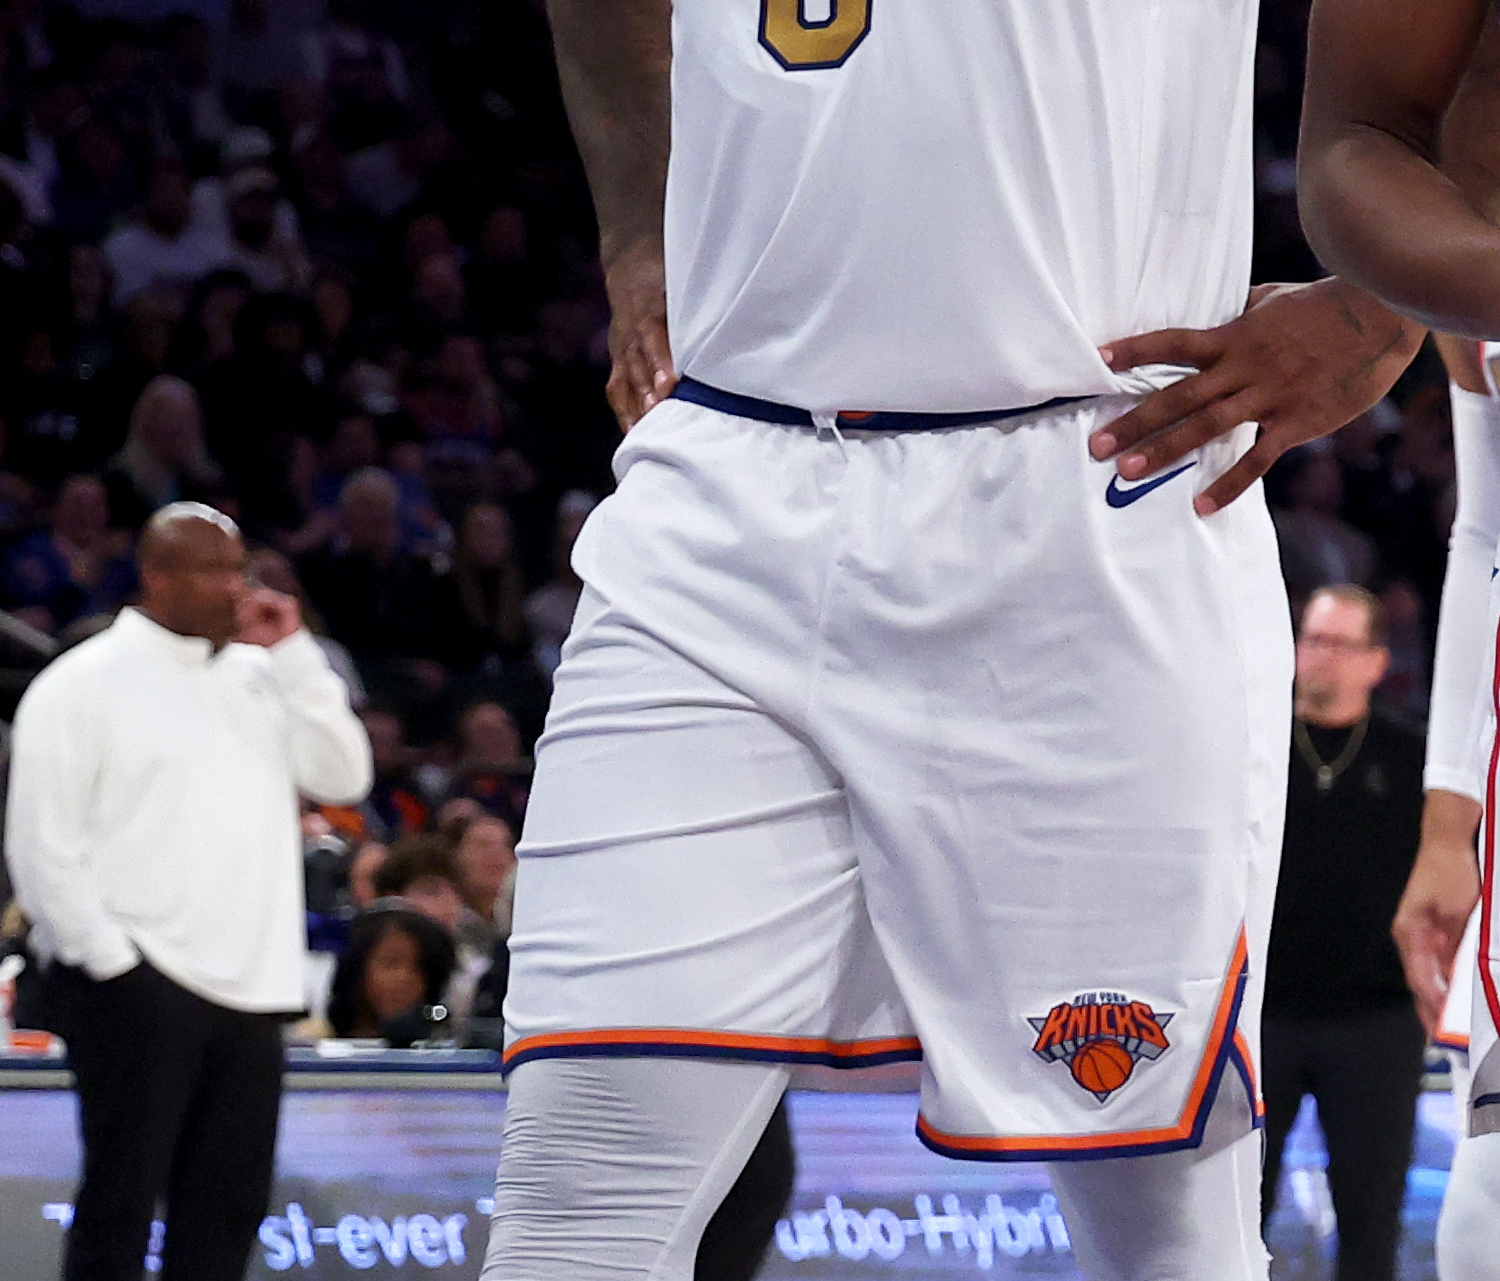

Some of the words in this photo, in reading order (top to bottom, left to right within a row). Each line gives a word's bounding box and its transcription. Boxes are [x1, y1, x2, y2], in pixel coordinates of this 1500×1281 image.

[1033, 1000, 1170, 1055] KNICKS
[258, 1202, 469, 1271] st-ever
[774, 1194, 1071, 1269] urbo-Hybri
